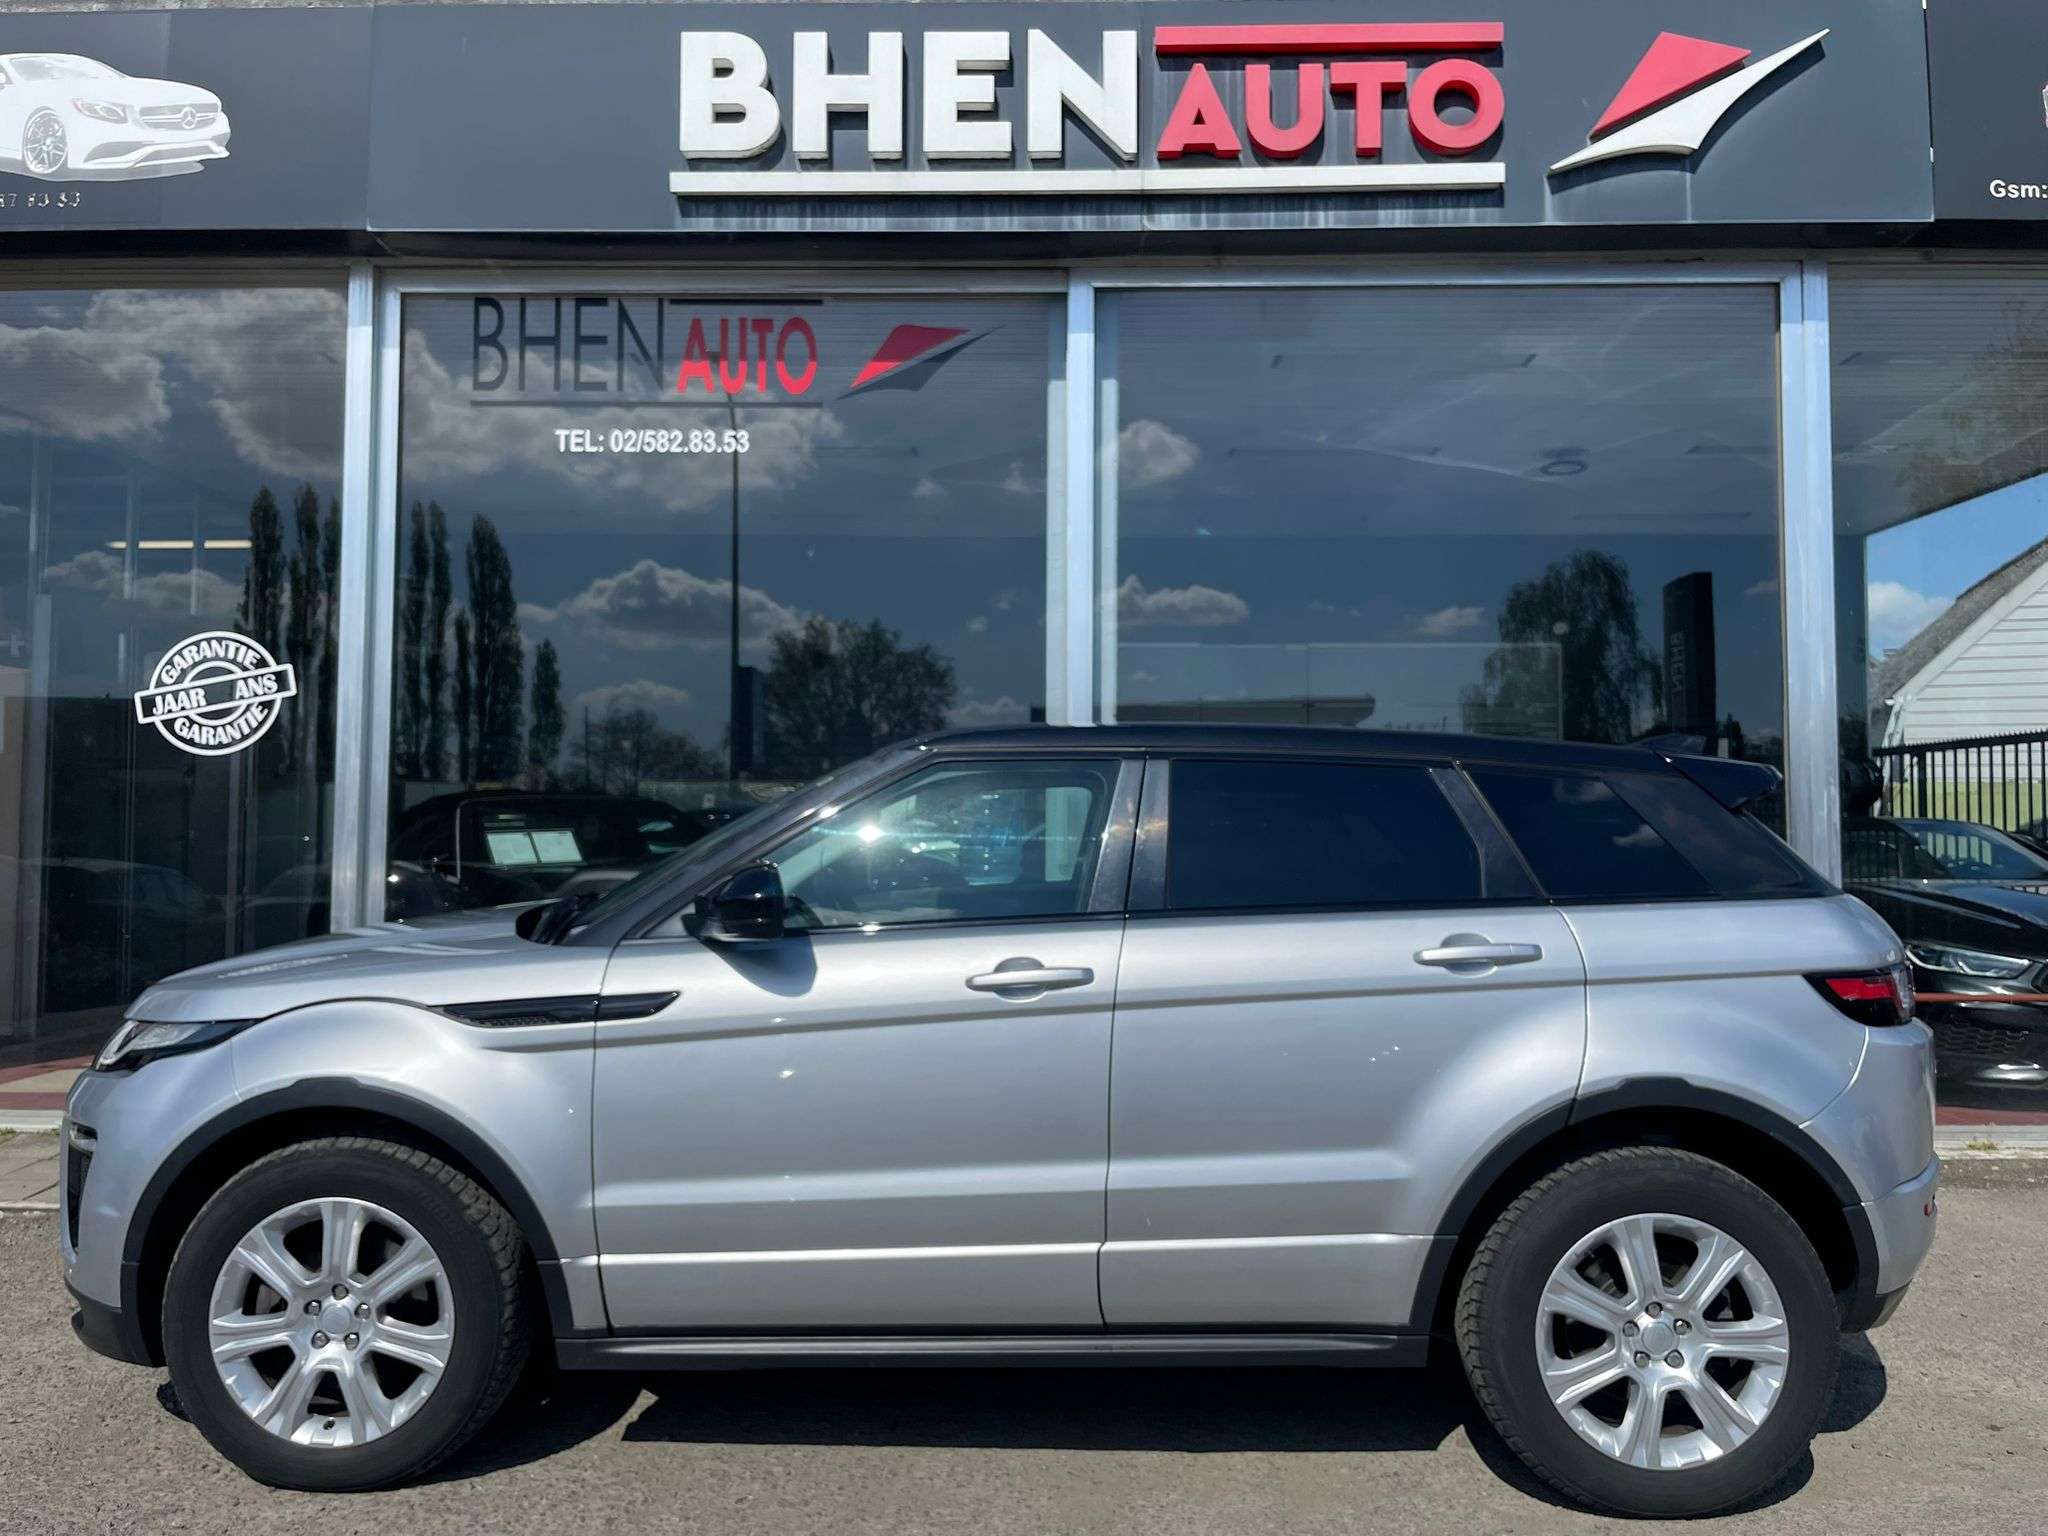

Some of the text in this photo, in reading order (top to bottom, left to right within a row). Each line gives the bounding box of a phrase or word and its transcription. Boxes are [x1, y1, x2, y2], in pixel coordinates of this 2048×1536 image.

[680, 29, 1505, 161] BHEN AUTO
[472, 296, 818, 396] BHEN AUTO
[555, 428, 751, 453] TEL: 02/582.83.53
[160, 639, 262, 685] GARANTIE
[152, 673, 279, 717] JAAR ANS
[173, 703, 269, 747] GARANTIE
